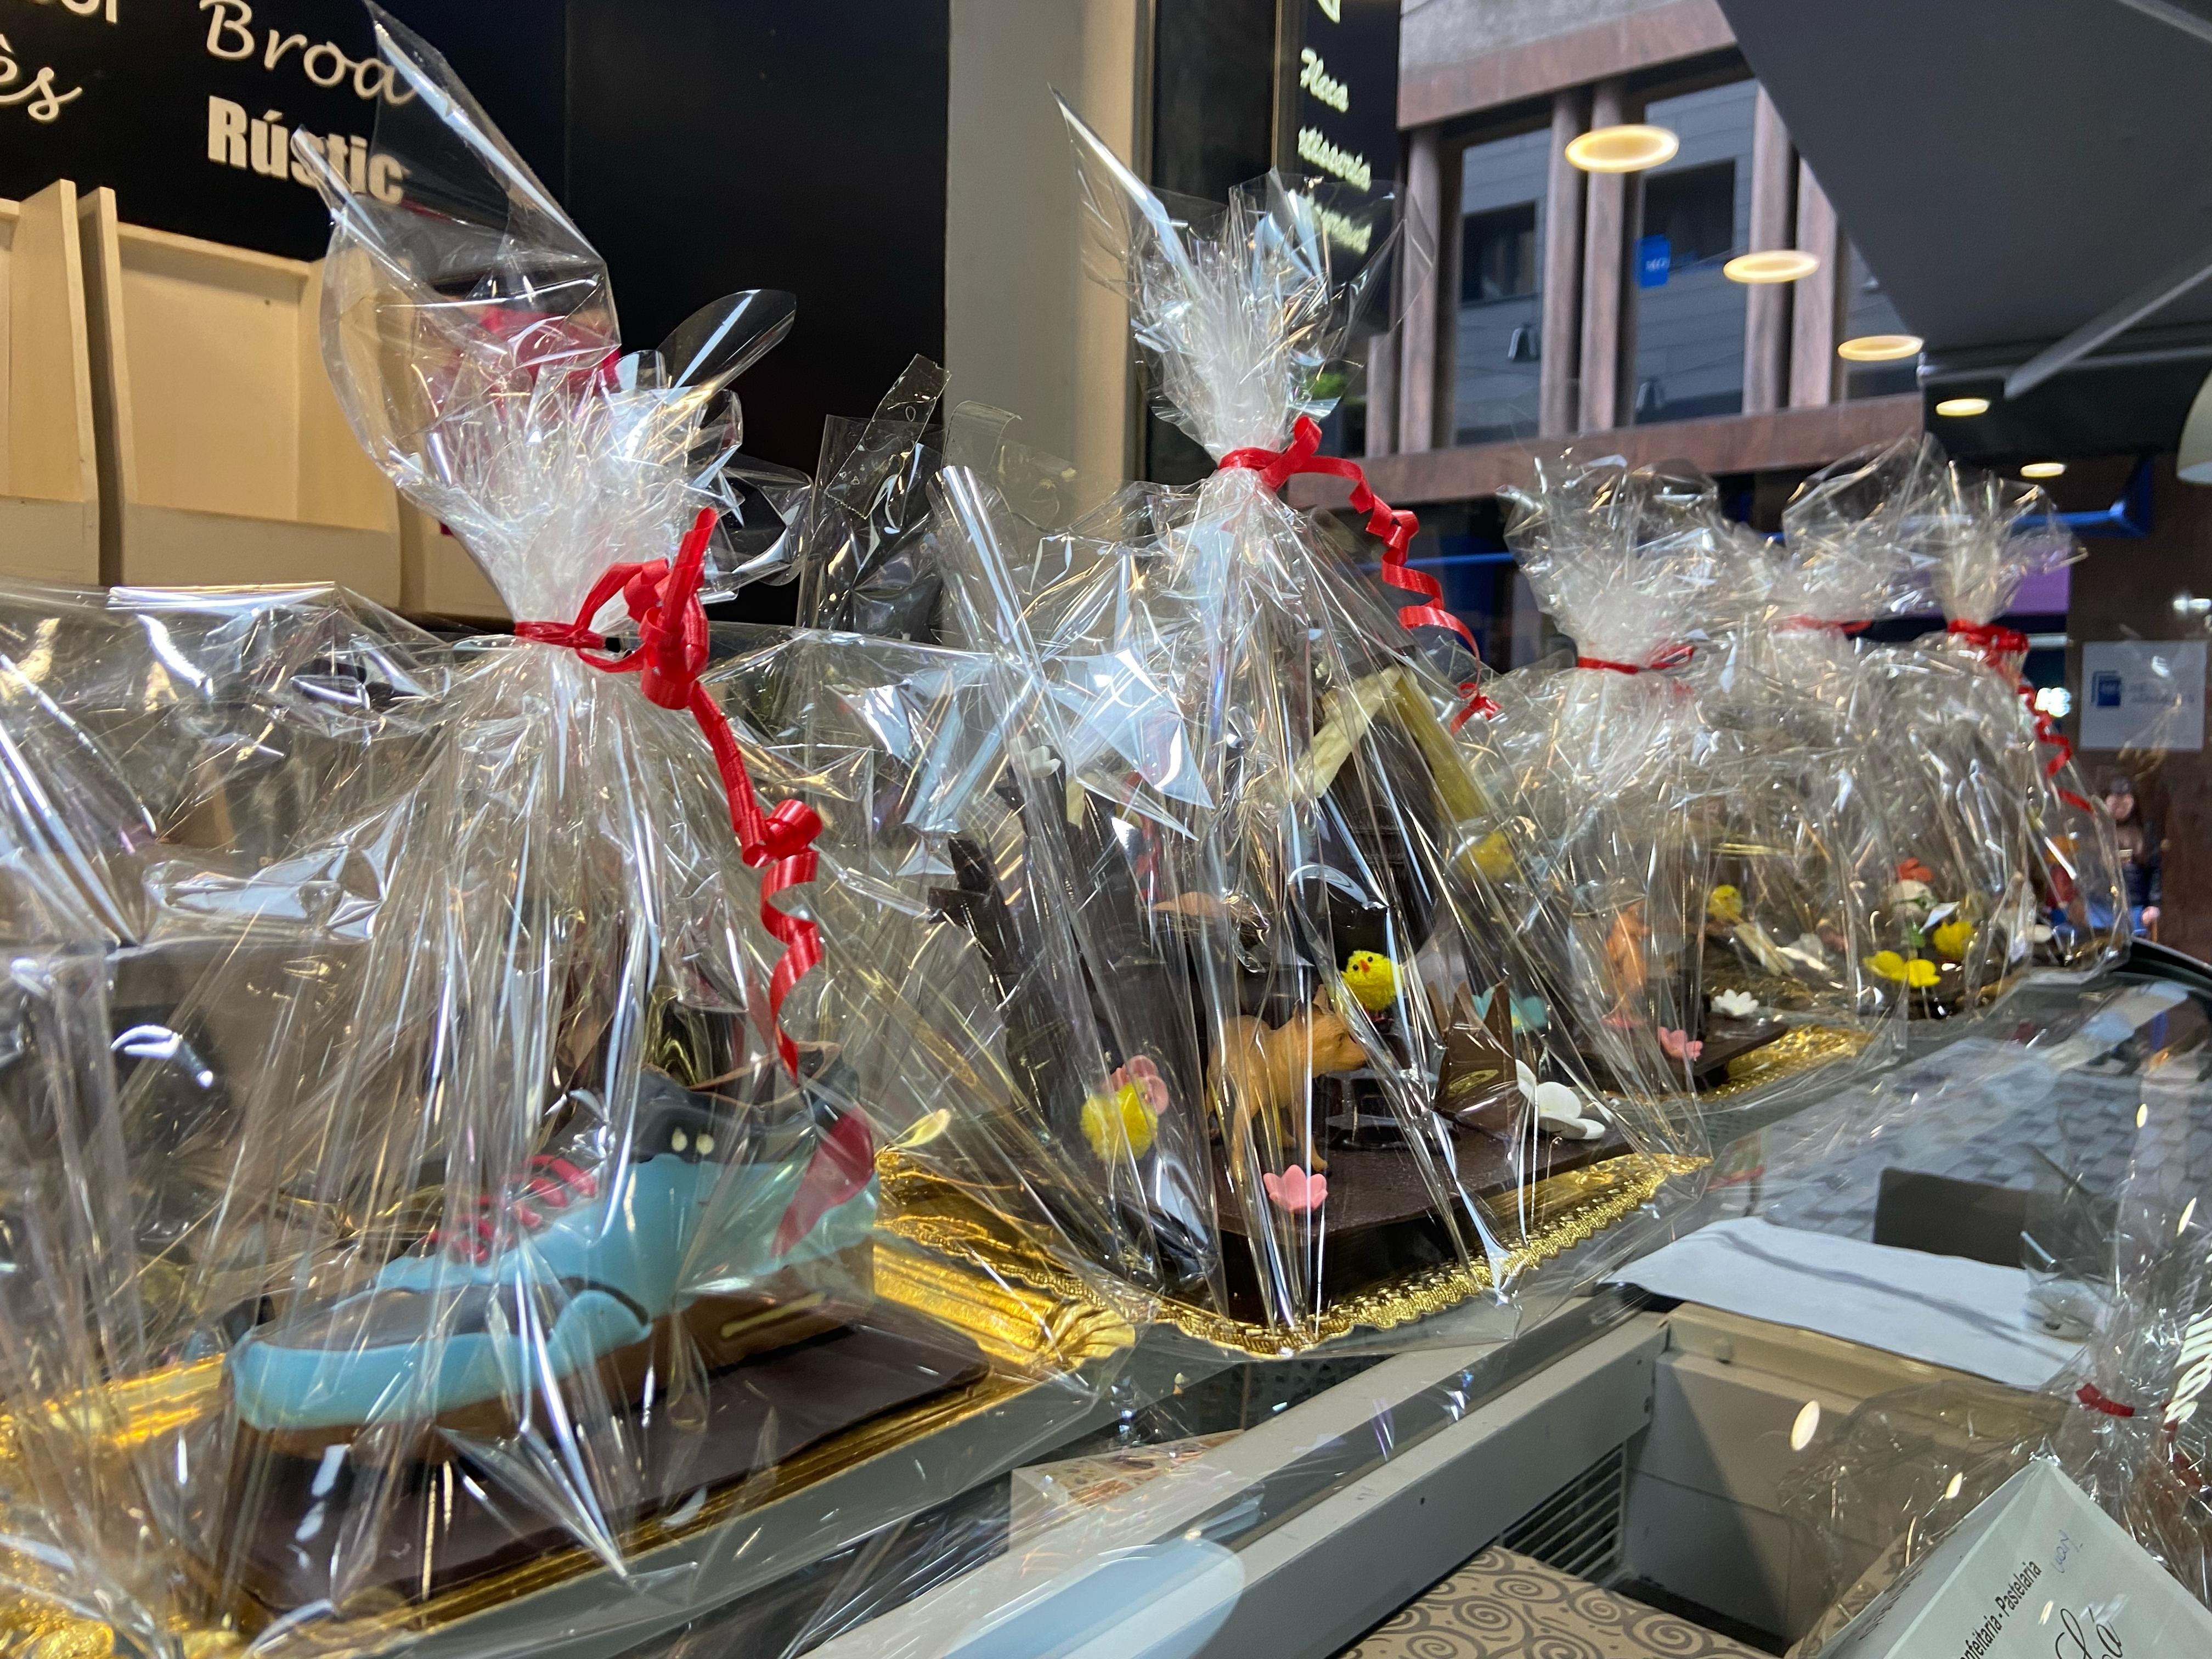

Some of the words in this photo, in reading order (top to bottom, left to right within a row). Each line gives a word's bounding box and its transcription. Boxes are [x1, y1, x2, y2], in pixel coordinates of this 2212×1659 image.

[199, 0, 418, 106] Broa
[1960, 1615, 2002, 1659] nfeitaria
[1995, 1561, 2042, 1617] Pastelaria
